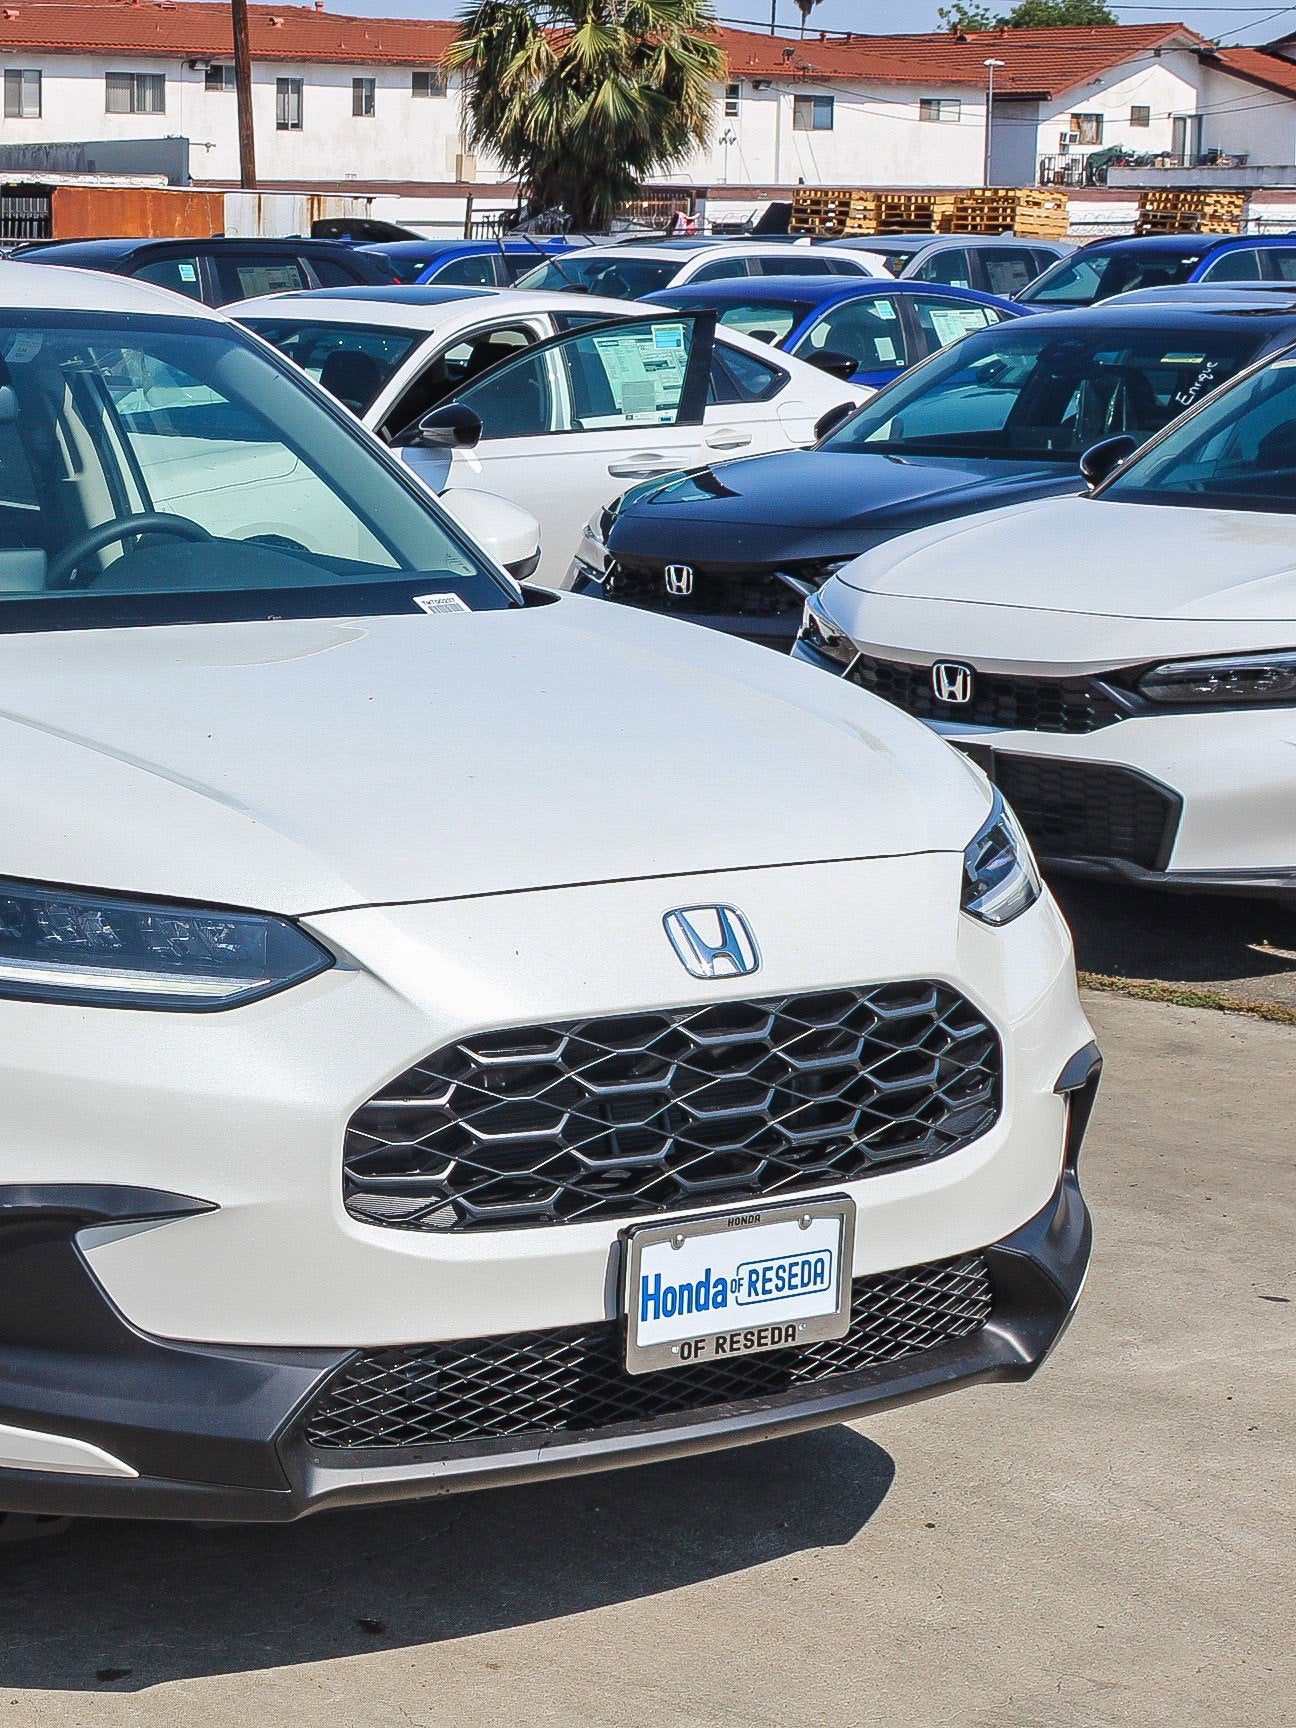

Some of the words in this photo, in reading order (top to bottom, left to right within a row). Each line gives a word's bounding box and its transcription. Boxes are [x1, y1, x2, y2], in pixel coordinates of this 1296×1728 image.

[727, 1214, 761, 1228] HONDA
[641, 1268, 728, 1322] Honda
[730, 1277, 744, 1294] OF
[747, 1257, 825, 1298] RESEDA
[680, 1339, 706, 1361] OF
[714, 1323, 797, 1355] RESEDA
